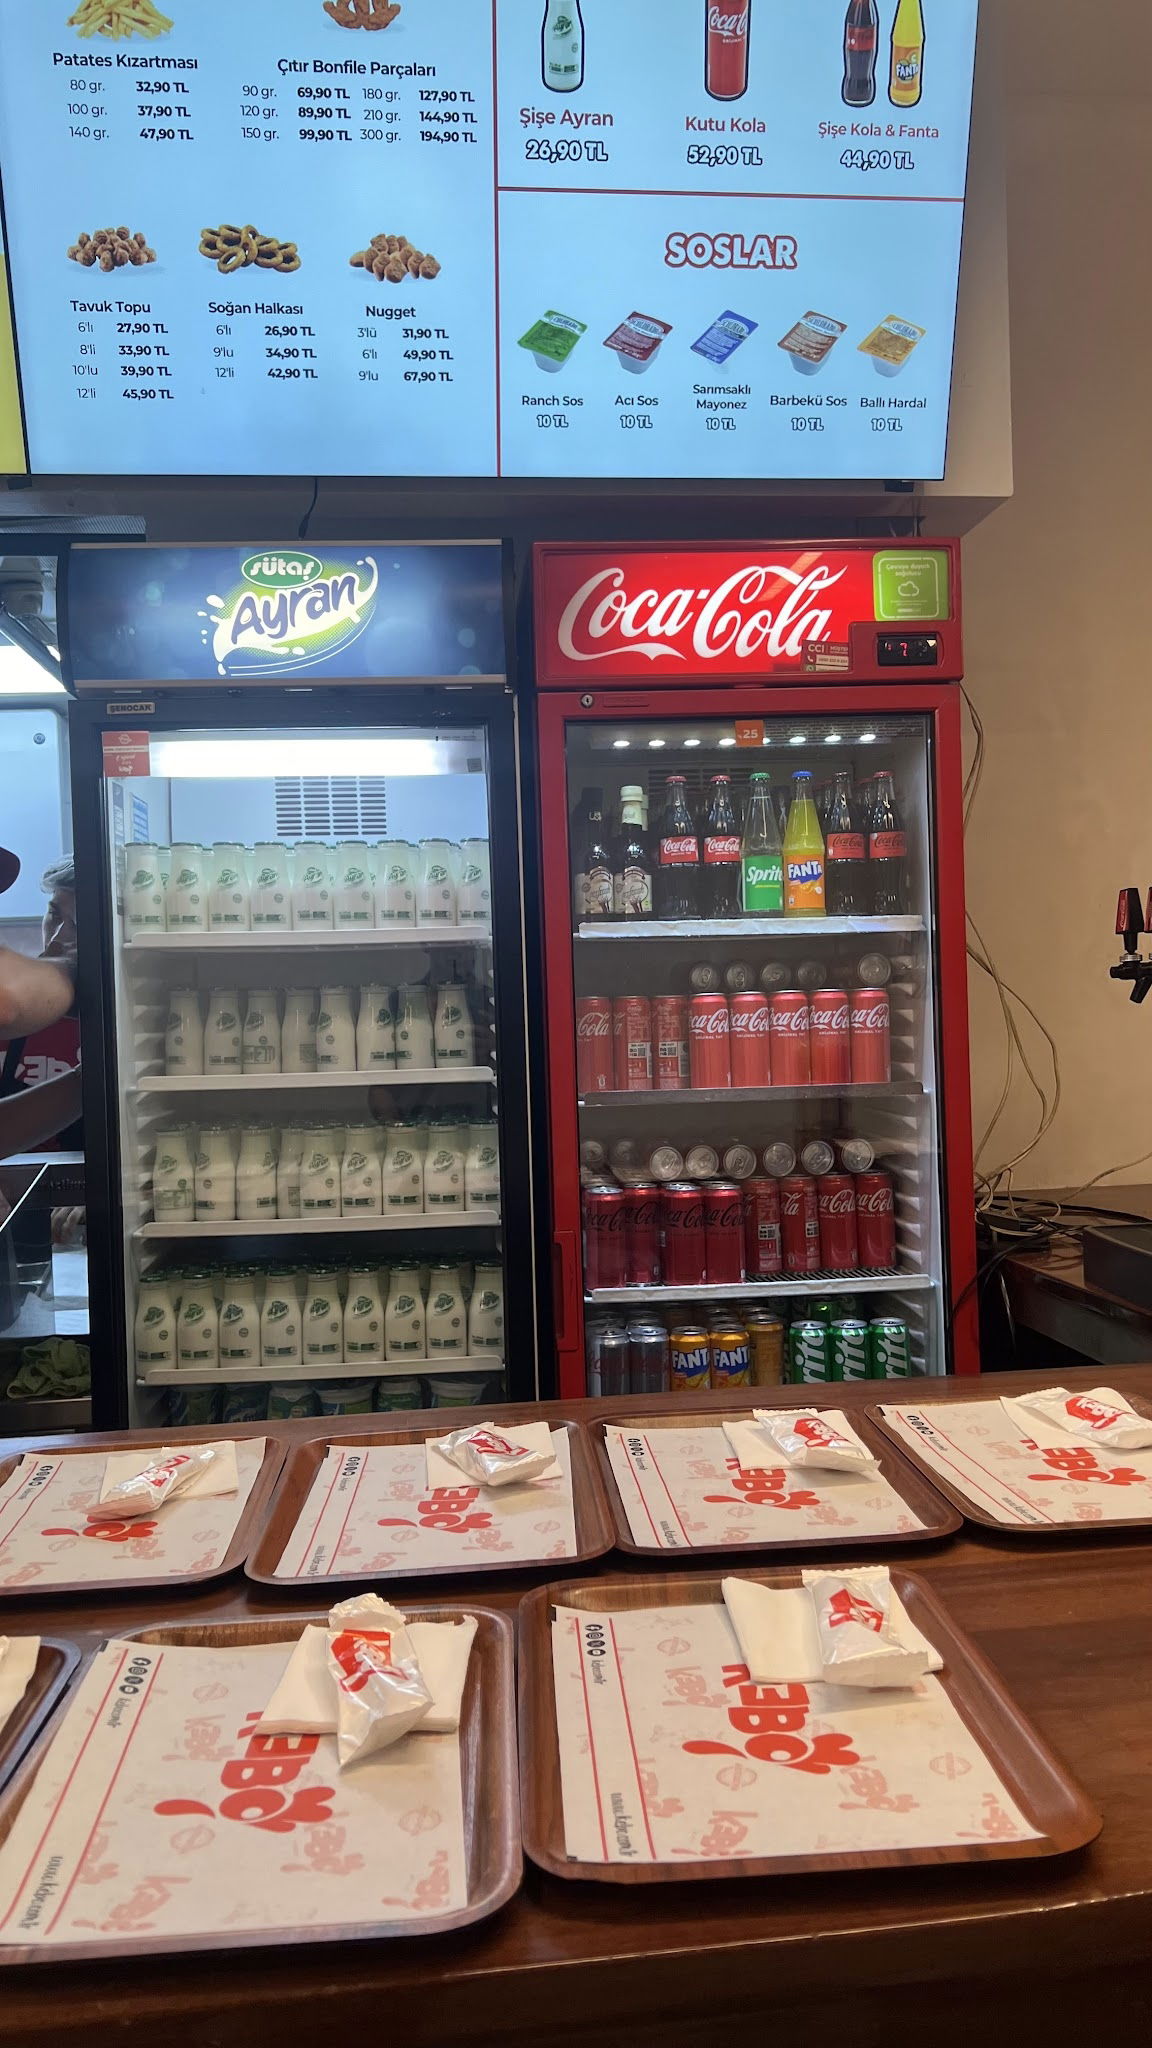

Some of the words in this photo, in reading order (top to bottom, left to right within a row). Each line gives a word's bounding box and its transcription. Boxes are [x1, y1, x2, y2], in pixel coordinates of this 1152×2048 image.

[52, 52, 113, 68] Patates
[116, 53, 198, 70] Kızartması
[277, 58, 310, 76] Çıtır
[312, 59, 367, 75] Bonfile
[370, 61, 436, 80] Parçaları
[69, 79, 87, 91] 80
[88, 81, 105, 94] gr.
[135, 80, 171, 95] 32,90
[172, 81, 190, 94] TL
[242, 84, 259, 97] 90
[260, 87, 277, 100] gr.
[297, 86, 333, 101] 69,90
[333, 87, 351, 100] TL
[362, 87, 383, 100] 180
[384, 91, 401, 103] gr.
[418, 89, 458, 104] 127,90
[459, 91, 476, 103] TL
[66, 103, 89, 115] 100
[91, 106, 108, 118] gr.
[137, 104, 173, 119] 37,90
[174, 106, 192, 118] TL
[239, 104, 260, 117] 120
[262, 107, 279, 120] gr.
[298, 106, 333, 121] 89,90
[334, 107, 352, 119] TL
[363, 109, 384, 121] 210
[385, 112, 401, 124] gr.
[418, 110, 460, 125] 144,90
[461, 112, 478, 124] TL
[519, 106, 556, 129] Şişe
[559, 108, 614, 130] Ayran
[685, 115, 726, 132] Kutu
[730, 117, 766, 133] Kola
[818, 120, 847, 139] Şişe
[850, 122, 882, 137] Kola
[885, 123, 896, 137] &
[898, 124, 939, 139] Fanta
[68, 125, 91, 138] 140
[92, 129, 110, 141] gr.
[139, 127, 176, 142] 47,90
[176, 128, 195, 141] TL
[240, 126, 262, 139] 150
[263, 129, 280, 142] gr.
[298, 128, 335, 143] 99,90
[335, 129, 353, 141] TL
[359, 128, 384, 141] 300
[385, 131, 402, 144] gr.
[419, 130, 460, 145] 194,90
[461, 131, 478, 143] TL
[525, 138, 583, 164] 26,90
[583, 140, 609, 162] TL
[686, 144, 740, 168] 52,90
[740, 145, 764, 166] TL
[839, 148, 892, 172] 44,90
[892, 150, 915, 170] TL
[663, 231, 799, 271] SOSLAR
[69, 300, 114, 313] Tavuk
[114, 301, 151, 316] Topu
[208, 301, 252, 317] Soğan
[254, 302, 304, 315] Halkası
[365, 305, 417, 321] Nugget
[116, 322, 151, 336] 27,90
[152, 323, 169, 334] TL
[264, 325, 298, 339] 26,90
[299, 326, 316, 337] TL
[402, 328, 432, 341] 31,90
[433, 328, 450, 339] TL
[118, 344, 152, 358] 33,90
[153, 345, 171, 356] TL
[265, 347, 300, 361] 34,90
[301, 348, 318, 359] TL
[402, 349, 437, 362] 49,90
[438, 349, 454, 361] TL
[120, 365, 155, 379] 39,90
[156, 366, 173, 377] TL
[267, 367, 301, 381] 42,90
[302, 368, 319, 379] TL
[403, 371, 437, 384] 67,90
[438, 371, 454, 382] TL
[122, 388, 157, 401] 45,90
[157, 388, 175, 400] TL
[692, 383, 751, 395] Sarımsaklı
[521, 394, 560, 406] Ranch
[562, 395, 584, 407] Sos
[614, 394, 635, 406] Acı
[636, 395, 659, 406] Sos
[696, 399, 748, 412] Mayonez
[769, 394, 823, 407] Barbekü
[825, 395, 848, 407] Sos
[860, 396, 885, 408] Ballı
[887, 397, 927, 409] Hardal
[535, 414, 552, 429] 10
[551, 414, 570, 429] TL
[619, 414, 636, 430] 10
[635, 414, 654, 429] TL
[705, 417, 721, 431] 10
[720, 417, 737, 431] TL
[790, 416, 807, 432] 10
[807, 416, 825, 432] TL
[870, 417, 887, 432] 10
[886, 417, 903, 432] TL
[250, 557, 315, 581] sütaş
[230, 575, 356, 645] Ayran
[558, 565, 849, 661] Coca-Cola
[808, 644, 825, 653] CCI
